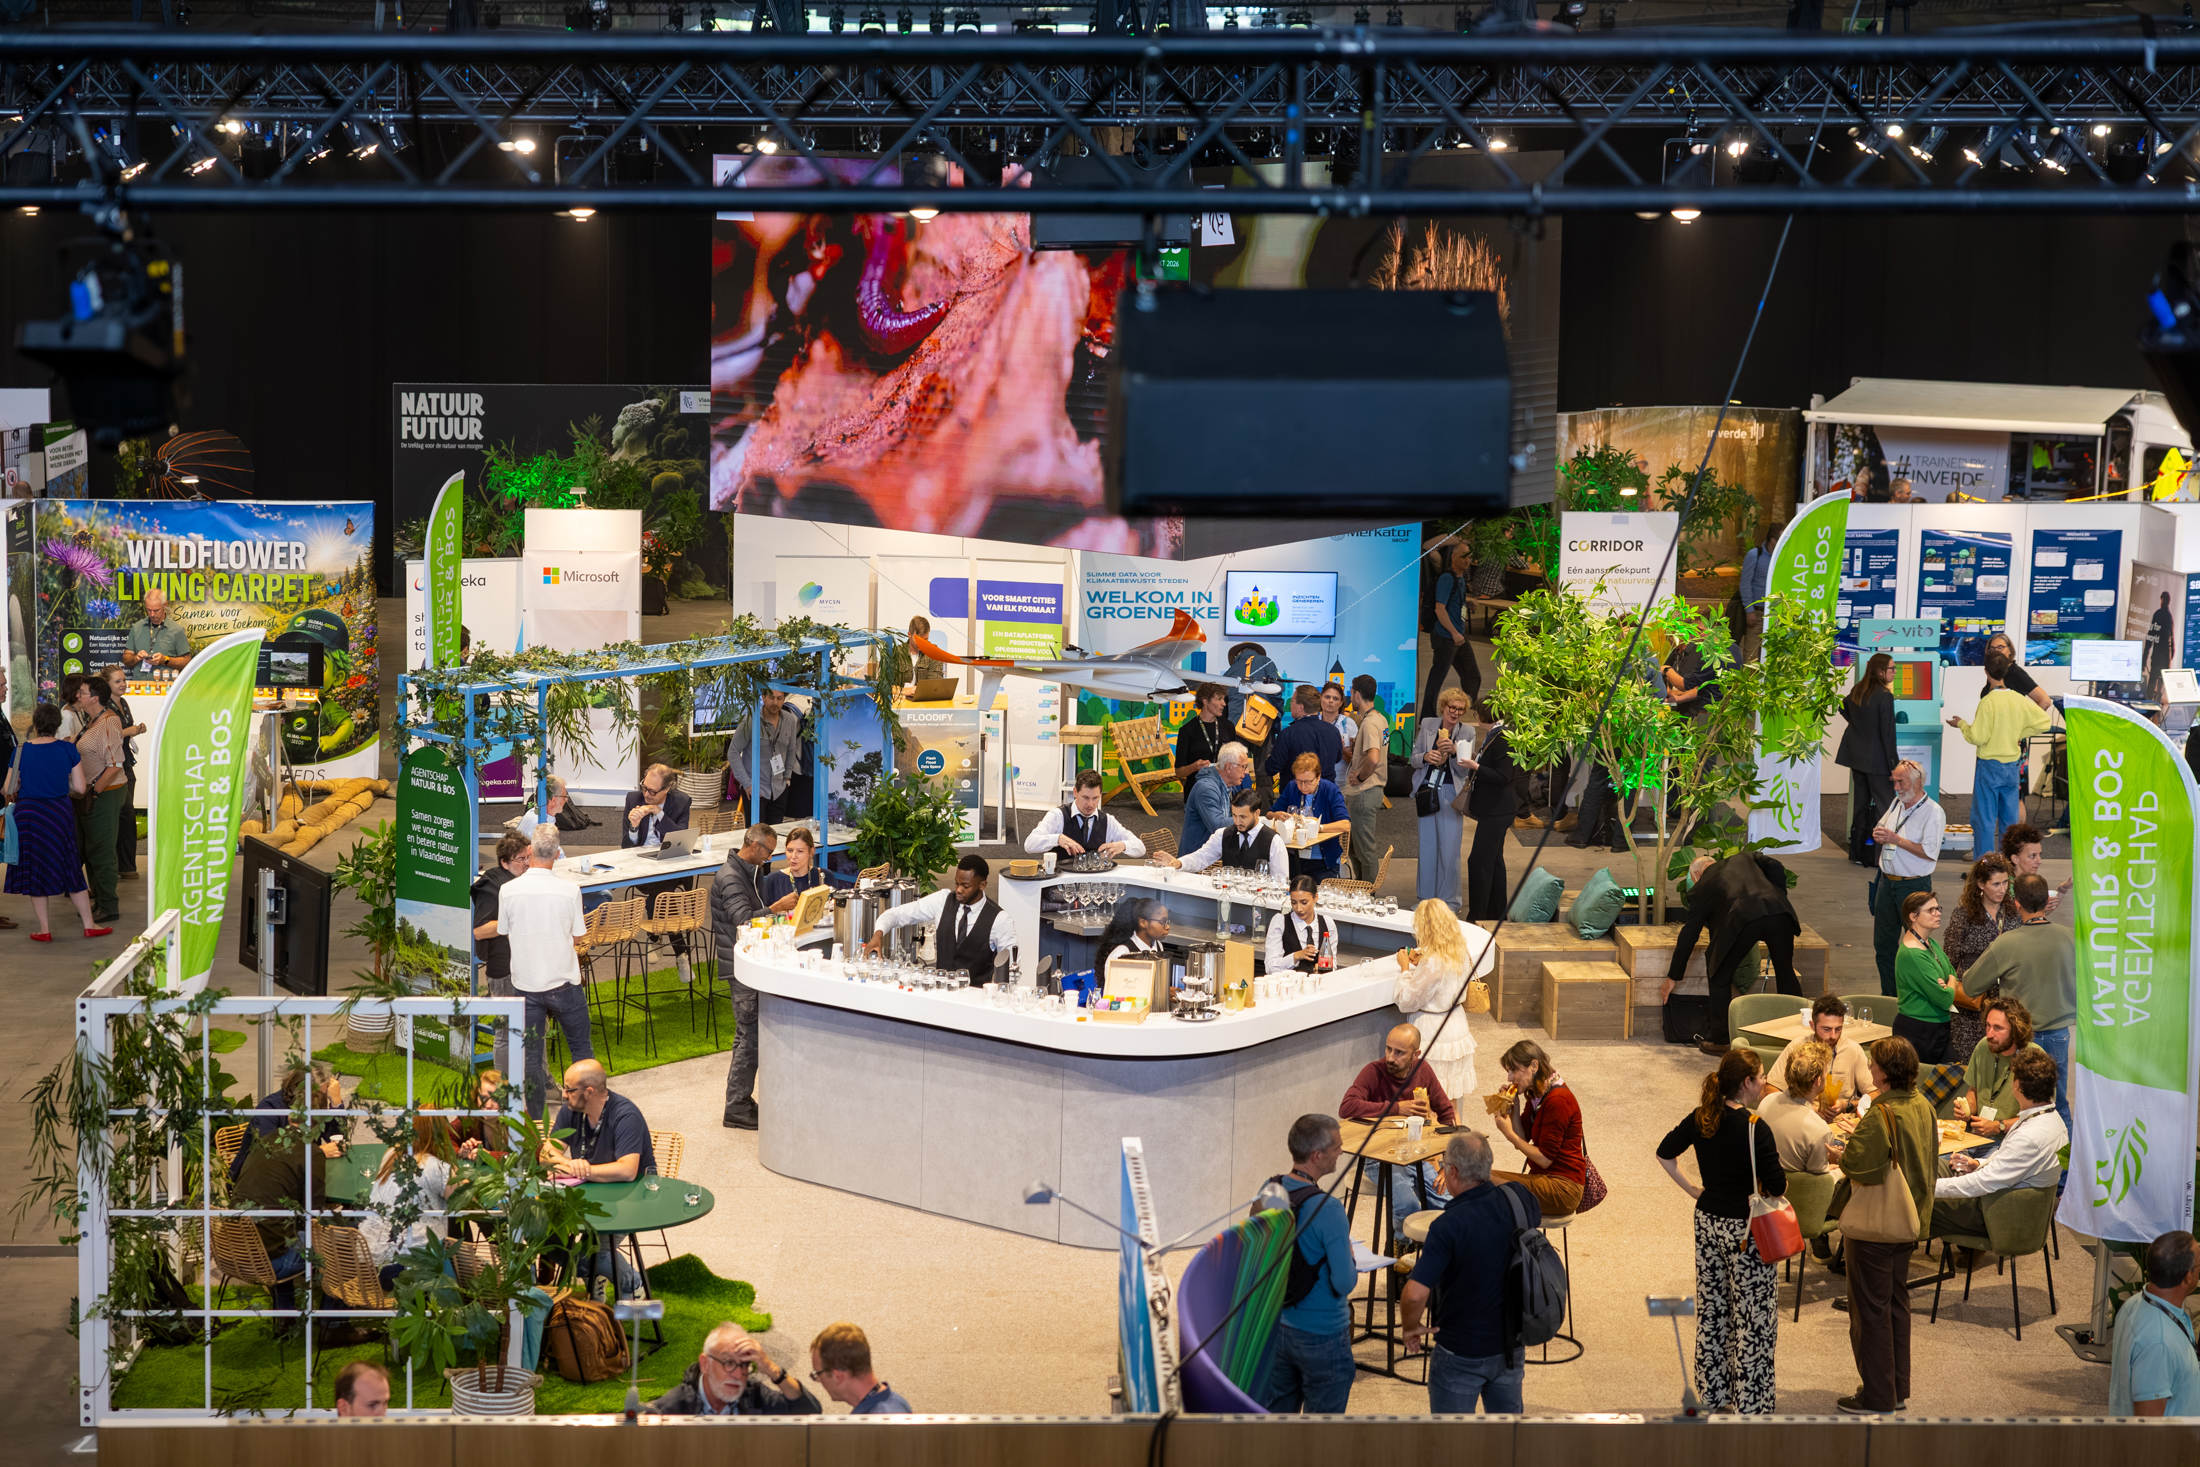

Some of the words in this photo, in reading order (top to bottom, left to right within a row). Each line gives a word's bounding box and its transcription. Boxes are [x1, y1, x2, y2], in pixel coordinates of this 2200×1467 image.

[1166, 260, 1180, 268] 2026
[401, 392, 486, 416] NATUUR
[402, 416, 484, 440] FUTUUR
[48, 446, 62, 454] VOOR
[62, 444, 74, 452] BETER
[49, 452, 74, 461] SAMENLEVEN
[50, 461, 62, 469] WILDE
[62, 459, 76, 467] DIEREN
[1914, 456, 1967, 469] TRAINED
[445, 506, 456, 556] BOS
[1569, 540, 1644, 552] CORRIDOR
[1813, 526, 1831, 574] BOS
[127, 540, 306, 570] WILDFLOWER
[445, 564, 454, 581] &
[564, 570, 620, 583] Microsoft
[1585, 567, 1650, 575] aanspreekpunt
[117, 572, 206, 601] LIVING
[460, 574, 486, 586] eka
[982, 594, 1004, 602] VOOR
[1005, 595, 1032, 603] SMART
[1086, 591, 1183, 603] WELKOM
[1192, 591, 1212, 603] IN
[1810, 584, 1825, 600] &
[173, 606, 216, 622] Samen
[220, 608, 242, 618] voor
[1018, 606, 1056, 614] FORMAAT
[2130, 603, 2143, 614] Vision
[186, 620, 229, 638] groenere
[1902, 624, 1934, 637] vito
[2128, 616, 2153, 631] technology
[2153, 622, 2161, 631] for
[1004, 632, 1055, 640] DATAPLATFORM,
[2130, 628, 2146, 639] better
[2146, 632, 2159, 643] world
[211, 708, 232, 765] BOS
[410, 766, 448, 782] AGENTSCHAP
[210, 776, 230, 795] &
[411, 777, 436, 791] NATUUR
[437, 784, 442, 792] &
[443, 784, 456, 796] BOS
[412, 808, 432, 822] Samen
[434, 816, 454, 829] zorgen
[182, 744, 206, 926] AGENTSCHAP
[422, 826, 436, 835] voor
[438, 829, 454, 840] meer
[407, 834, 414, 842] en
[416, 836, 436, 848] betere
[438, 841, 459, 854] natuur
[206, 804, 229, 924] NATUUR
[411, 846, 417, 855] in
[419, 847, 455, 866] Vlaanderen.
